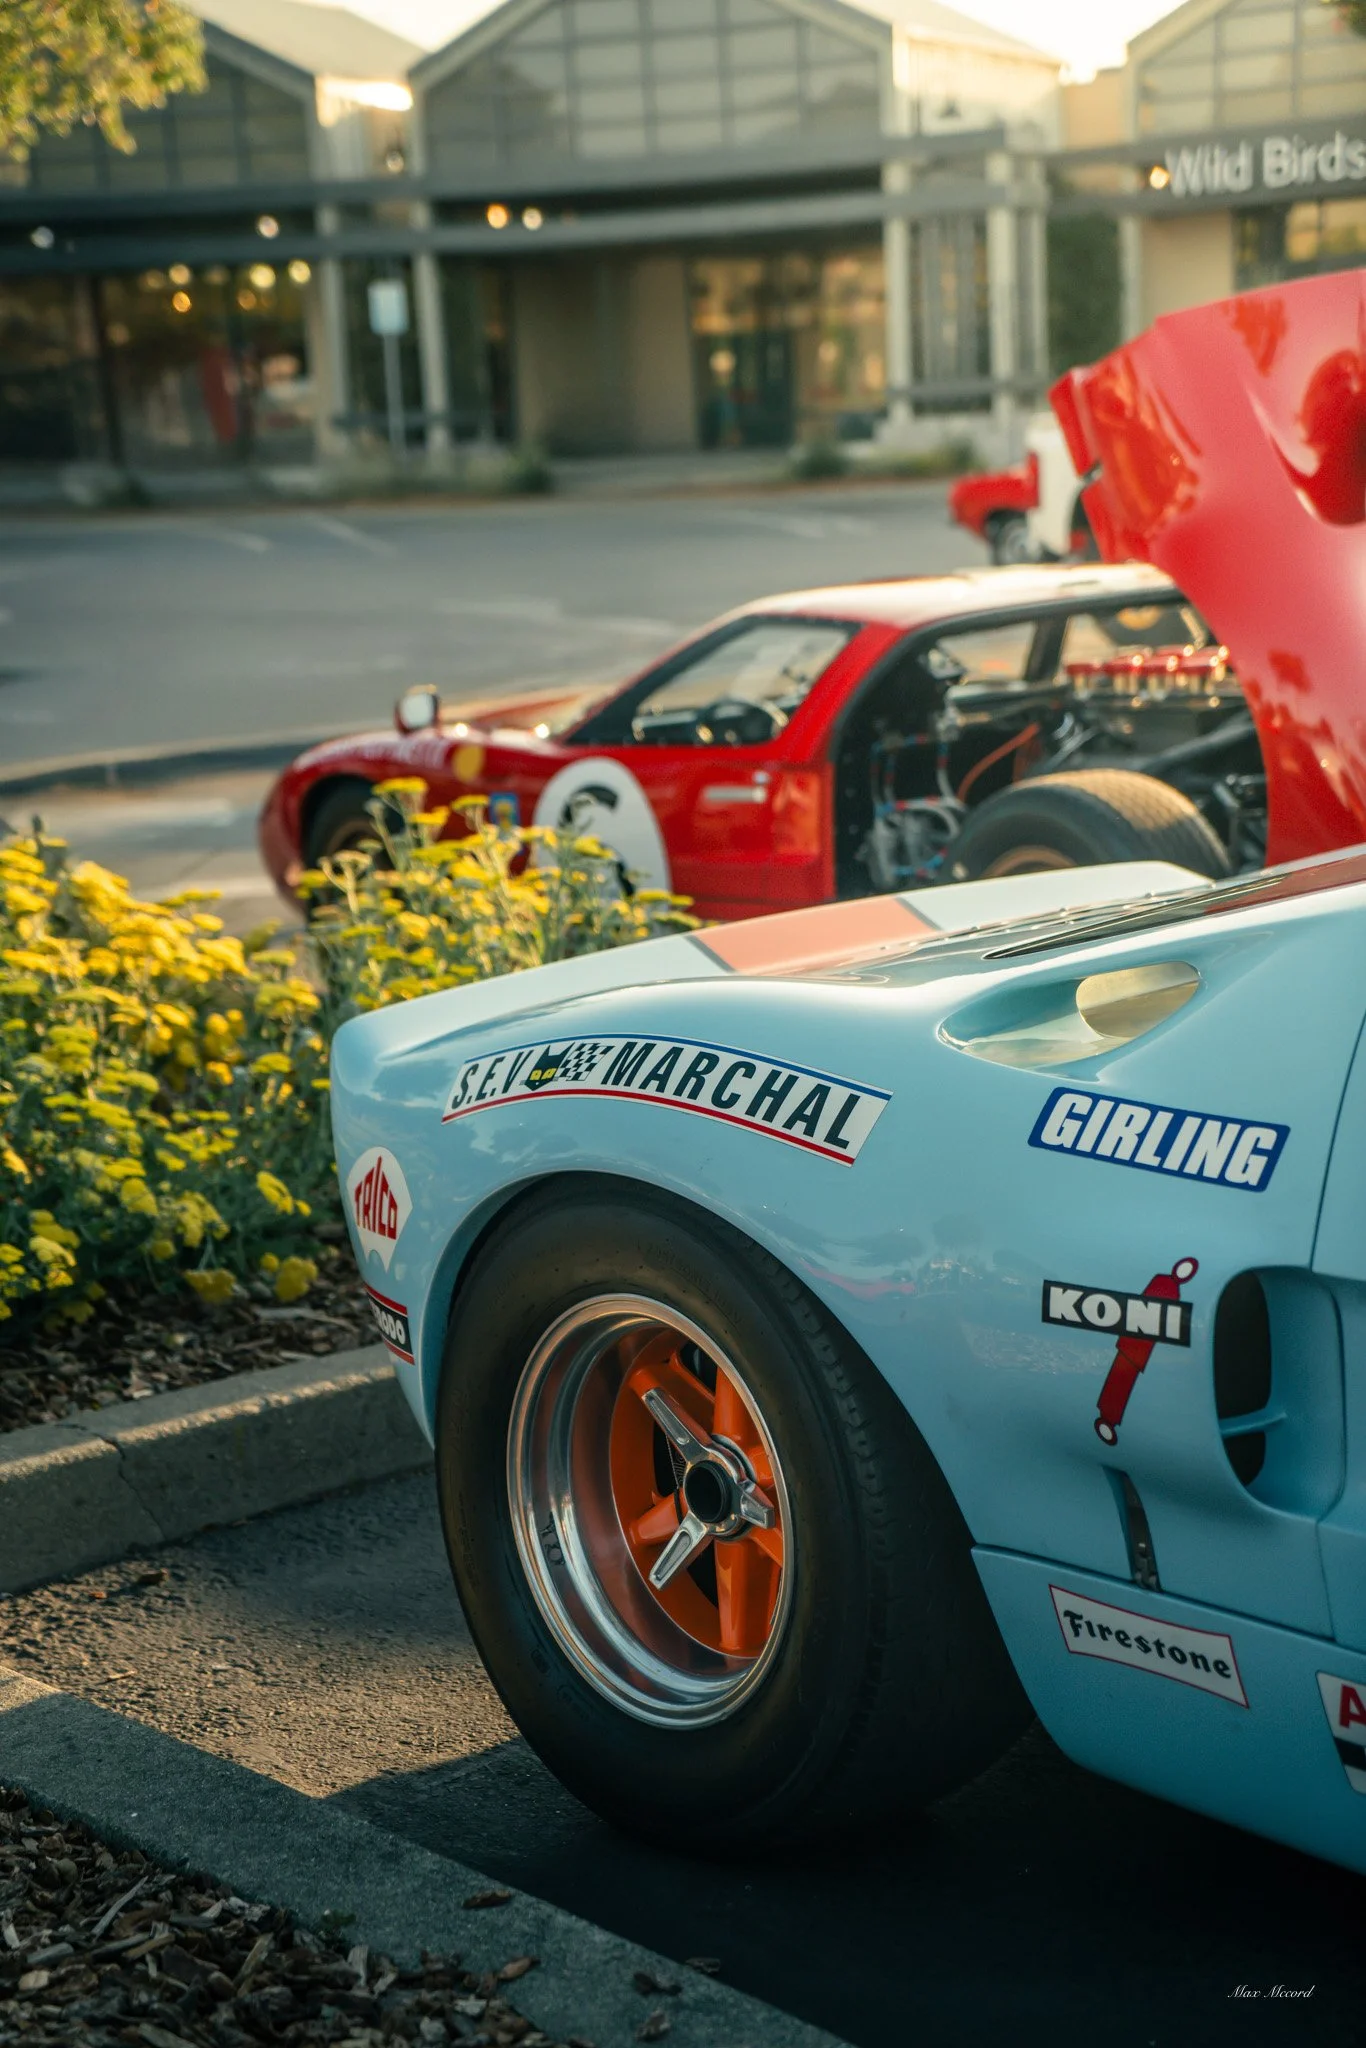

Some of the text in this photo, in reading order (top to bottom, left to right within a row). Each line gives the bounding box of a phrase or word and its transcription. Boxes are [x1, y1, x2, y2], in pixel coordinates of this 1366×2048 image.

[1165, 131, 1366, 196] Wild Birds
[600, 1041, 862, 1150] MARCHAL
[1040, 1092, 1278, 1187] GIRLING
[354, 1155, 399, 1241] TRICO
[1049, 1285, 1183, 1341] KONI
[1062, 1609, 1232, 1680] Firestone
